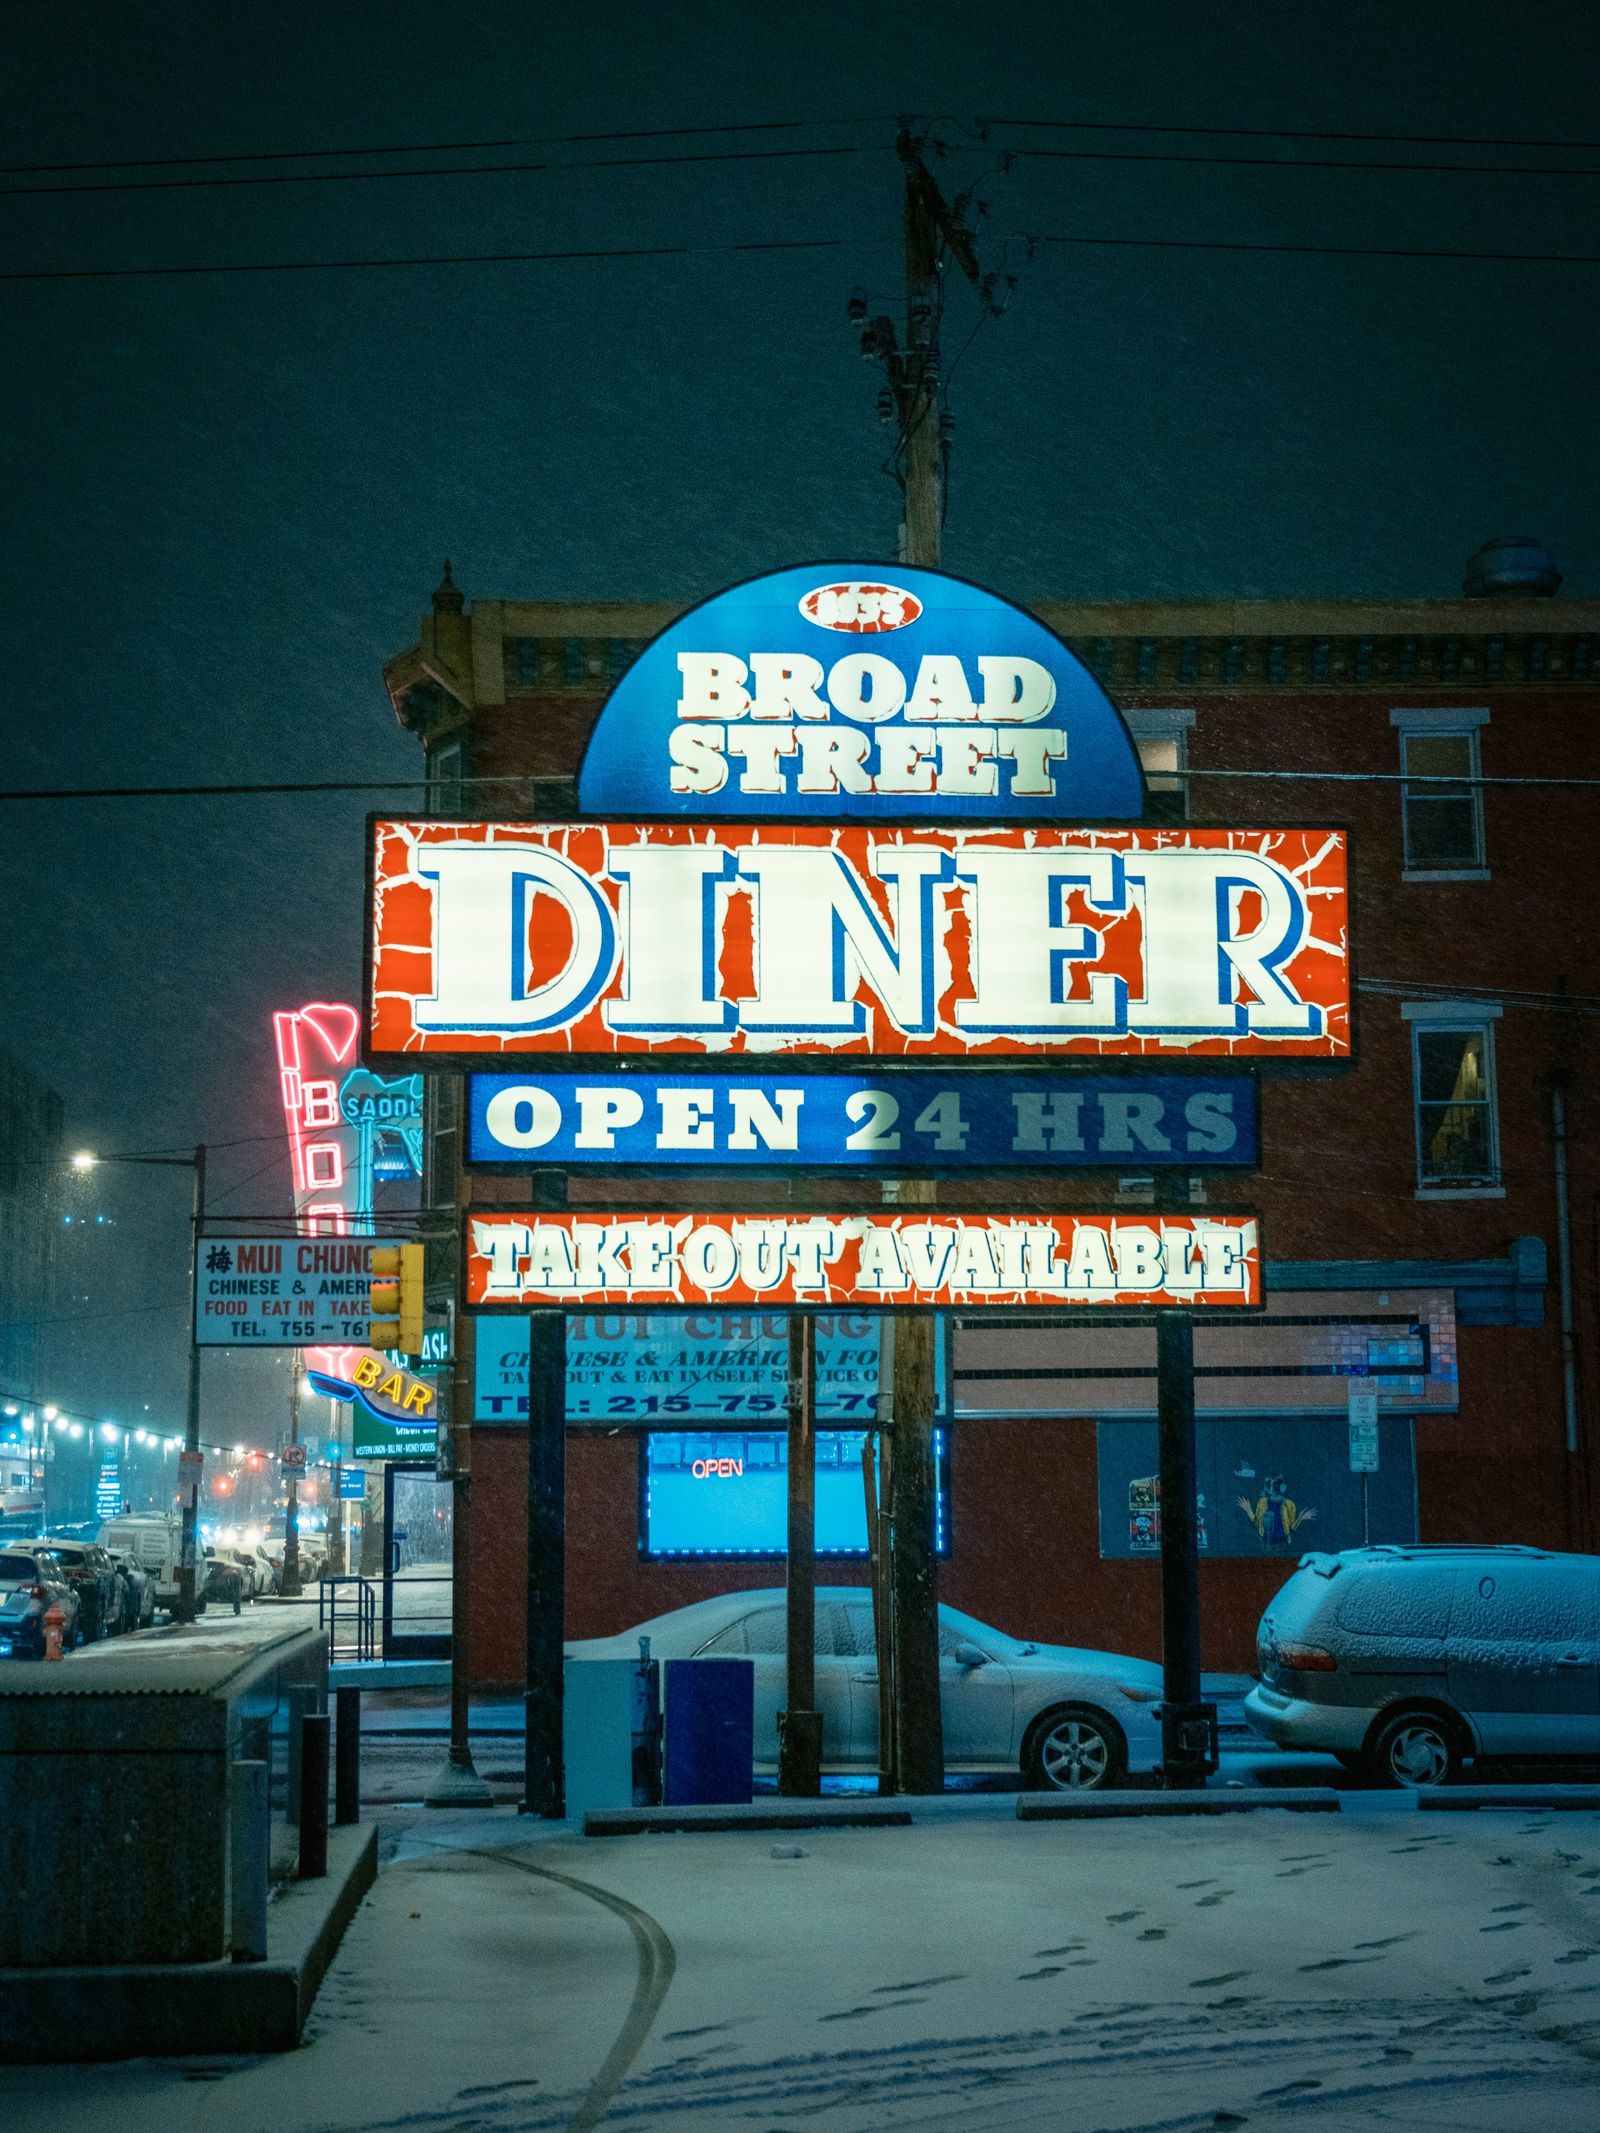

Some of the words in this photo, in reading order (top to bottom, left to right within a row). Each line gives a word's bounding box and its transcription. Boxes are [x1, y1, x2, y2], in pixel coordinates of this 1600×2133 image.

[676, 651, 1057, 723] BROAD
[668, 723, 1068, 797] STREET
[413, 847, 1323, 1036] DINER
[486, 1085, 804, 1150] OPEN
[845, 1090, 970, 1150] 24
[1011, 1092, 1238, 1152] HRS
[237, 1246, 282, 1273] MUI
[481, 1229, 673, 1288] TAKE
[694, 1225, 833, 1289] OUT
[855, 1230, 1244, 1289] AVAILABLE
[209, 1279, 280, 1295] CHINESE
[292, 1280, 306, 1294] &
[205, 1301, 247, 1316] FOOD
[262, 1301, 291, 1315] EAT
[299, 1301, 314, 1315] IN
[330, 1301, 370, 1316] TAKE
[231, 1322, 266, 1337] TEL:
[635, 1351, 657, 1367] &
[670, 1350, 830, 1367] AMERICN
[352, 1355, 433, 1416] BAR
[610, 1371, 628, 1384] &
[635, 1370, 674, 1383] EAT
[680, 1370, 701, 1383] IN
[692, 1458, 743, 1479] OPEN
